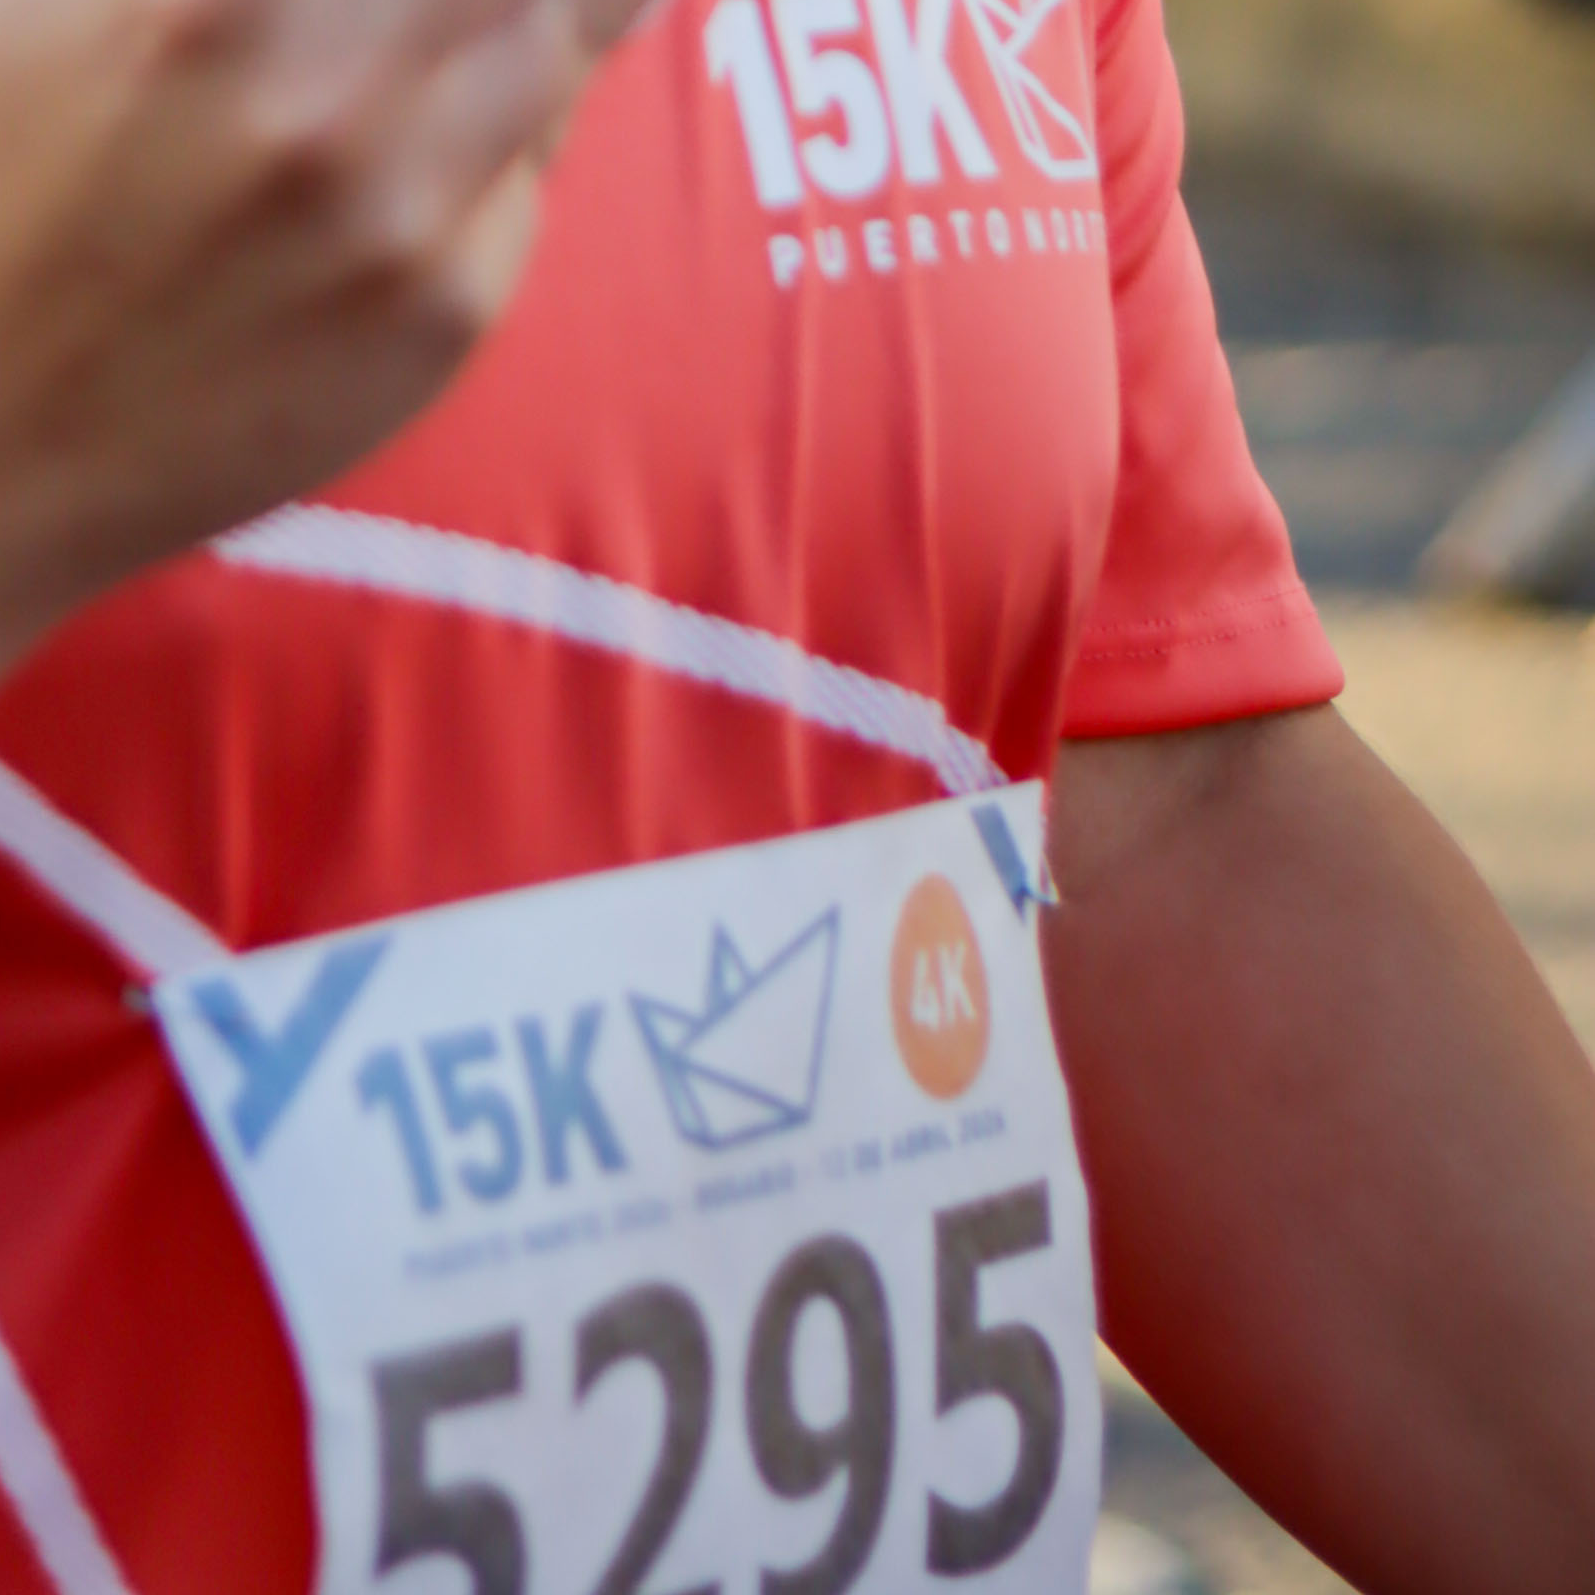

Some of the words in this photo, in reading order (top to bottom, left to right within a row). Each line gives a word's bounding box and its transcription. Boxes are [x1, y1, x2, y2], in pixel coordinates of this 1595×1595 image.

[910, 940, 977, 1033] 4K
[354, 1001, 628, 1214] 15K
[370, 1178, 1065, 1595] 5295
